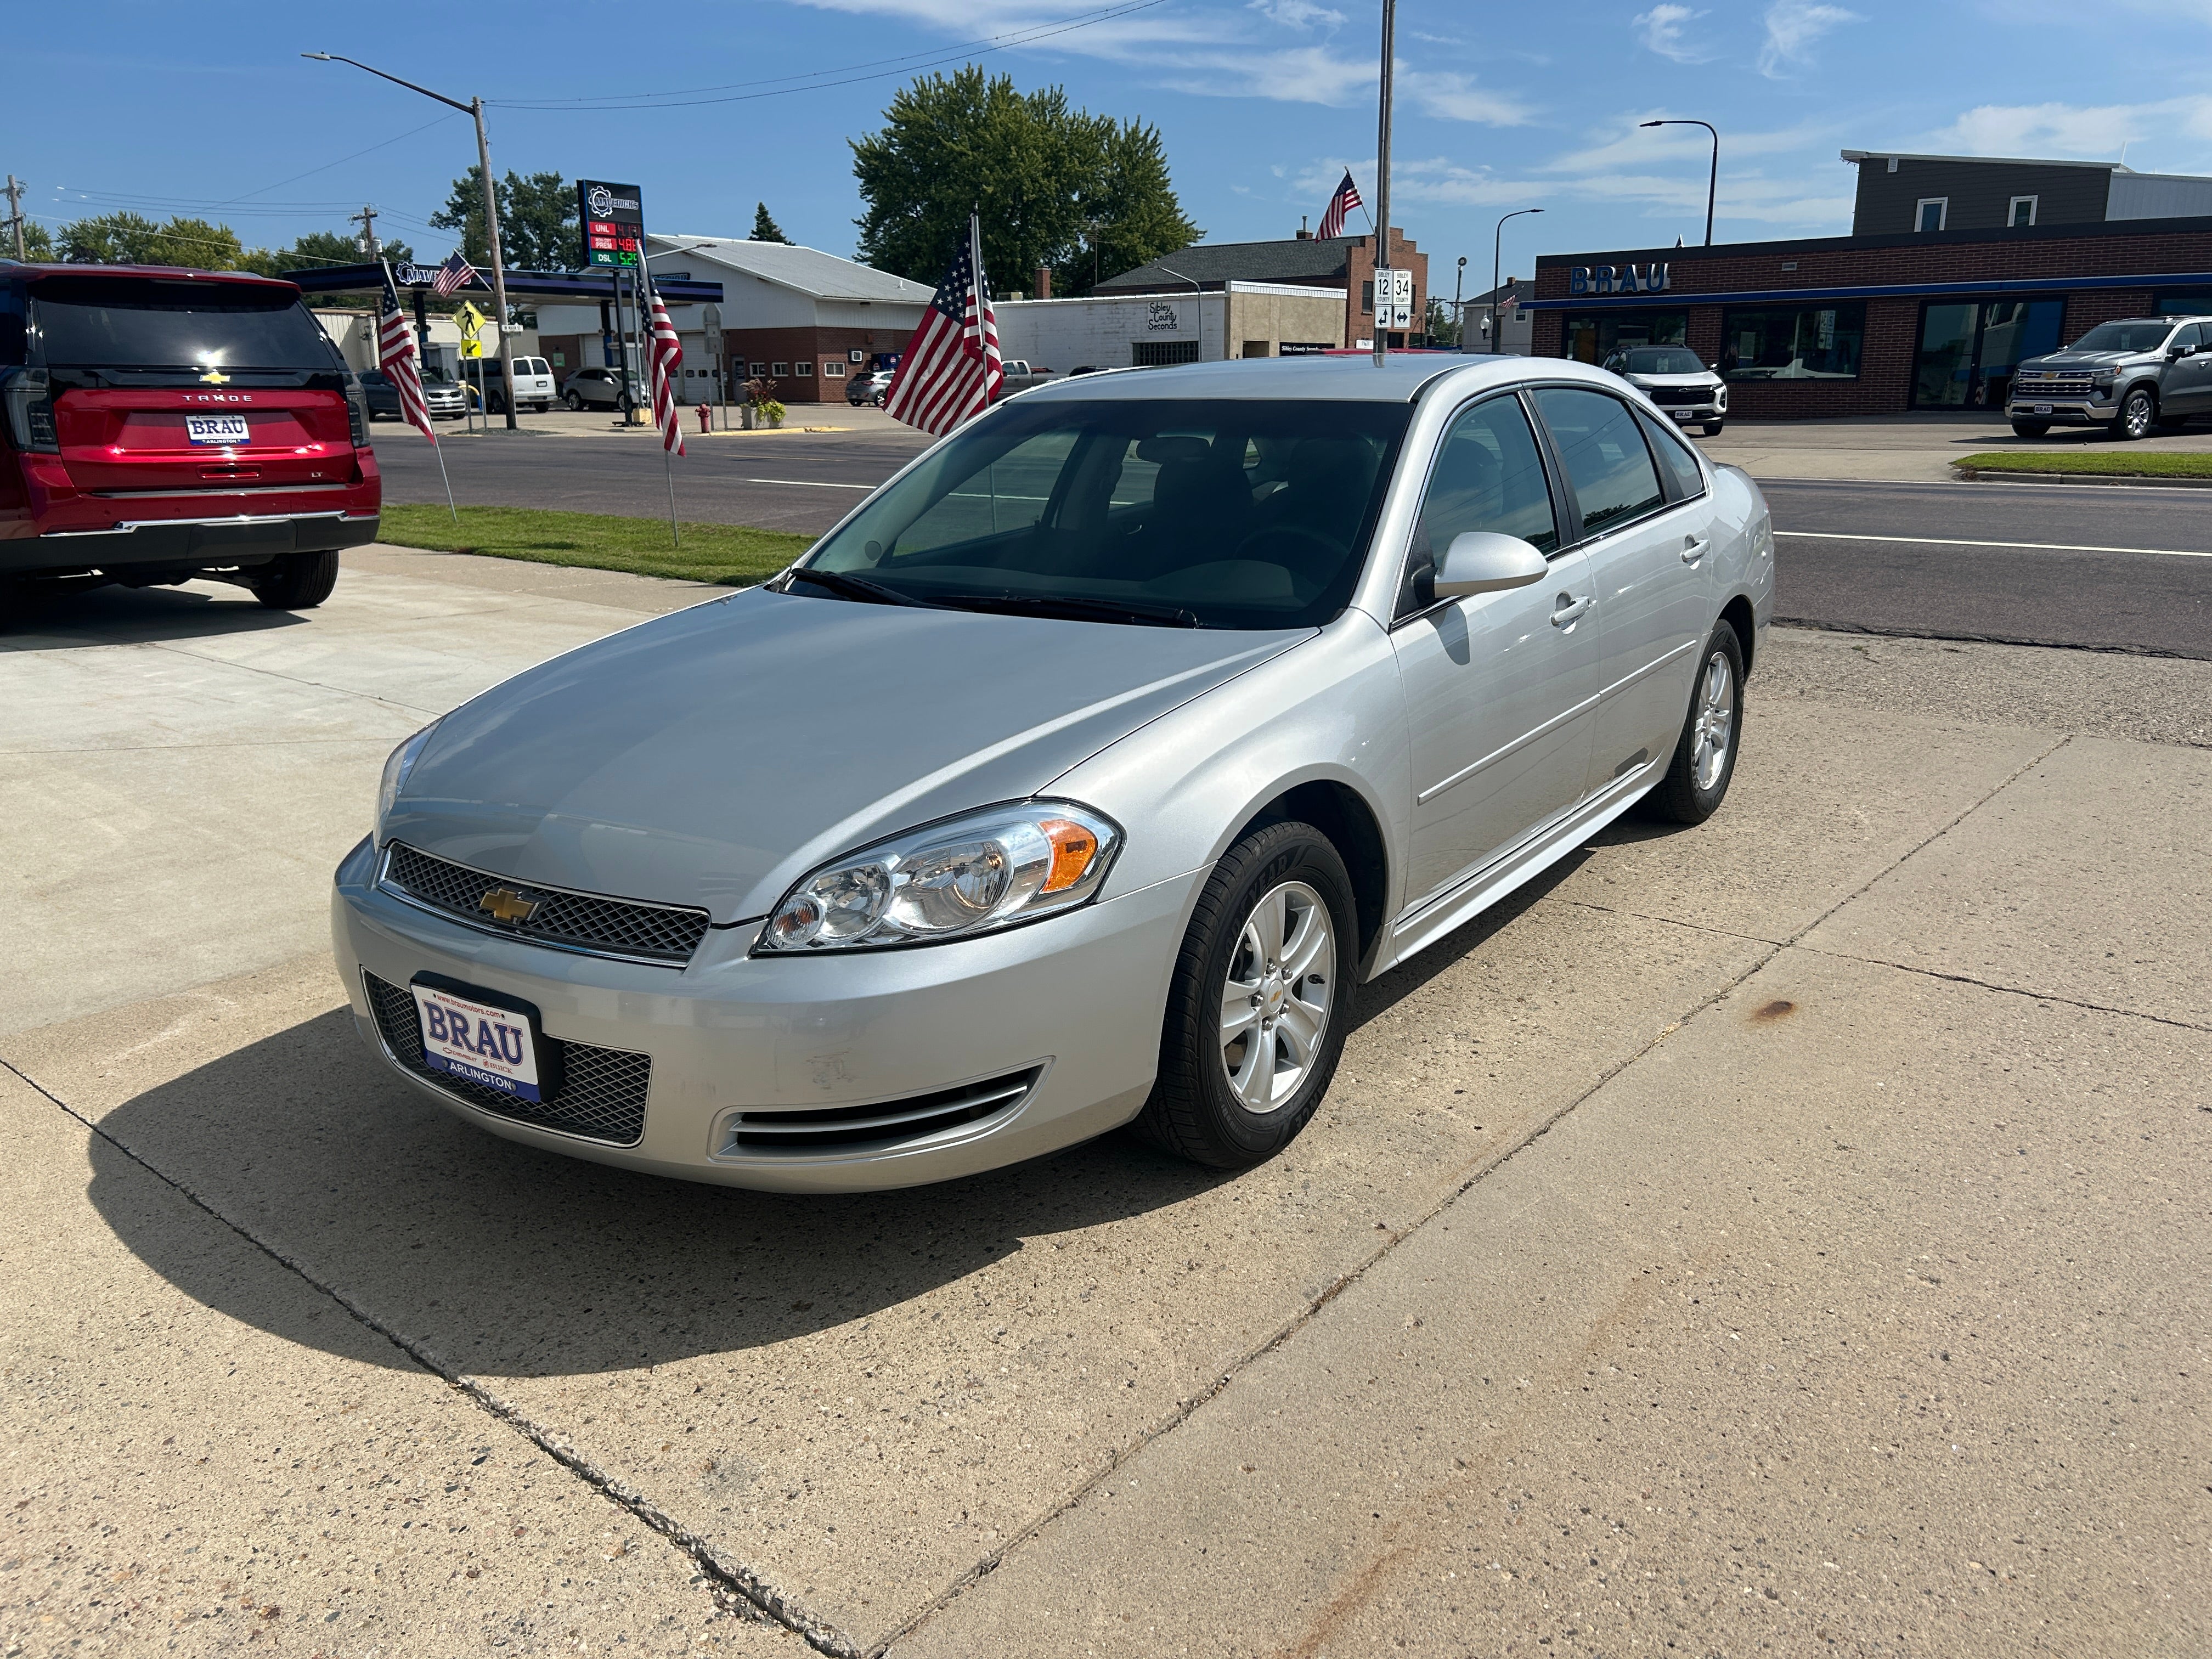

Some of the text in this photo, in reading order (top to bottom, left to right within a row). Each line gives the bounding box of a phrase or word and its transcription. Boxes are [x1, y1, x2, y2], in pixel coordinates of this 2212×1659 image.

[595, 224, 610, 233] UNL
[598, 254, 612, 262] DSL
[1570, 263, 1668, 294] BRAU
[1379, 279, 1389, 295] 12
[1396, 280, 1408, 295] 34
[1150, 302, 1171, 314] Sibley
[1148, 319, 1177, 330] Seconds
[1154, 311, 1176, 323] County
[190, 419, 244, 434] BRAU
[436, 995, 500, 1018] www.braumotors.com
[422, 999, 523, 1066] BRAU
[450, 1062, 512, 1090] ARLINGTON
[489, 1063, 514, 1074] BUICK
